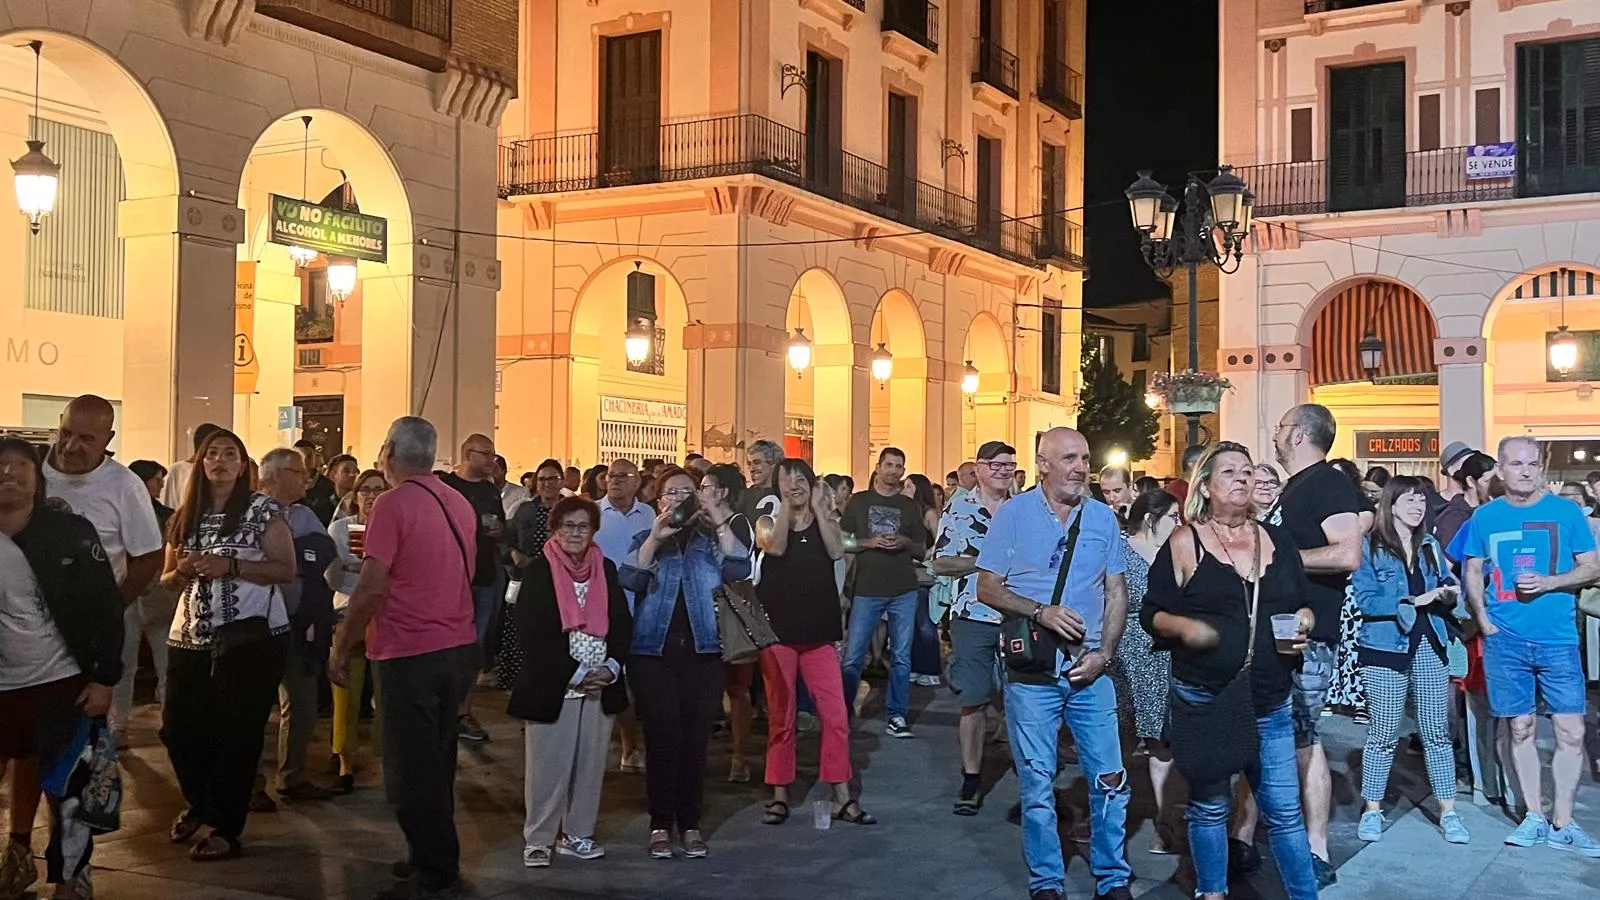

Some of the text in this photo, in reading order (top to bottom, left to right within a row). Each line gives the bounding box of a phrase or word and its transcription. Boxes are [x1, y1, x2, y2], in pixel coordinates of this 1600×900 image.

[1469, 159, 1512, 169] SE VENDE
[277, 201, 382, 234] YO NO FACILITO
[275, 219, 327, 241] ALCOHOL
[330, 230, 337, 243] A
[337, 232, 383, 251] MENORES
[1369, 438, 1420, 452] CALZADOS
